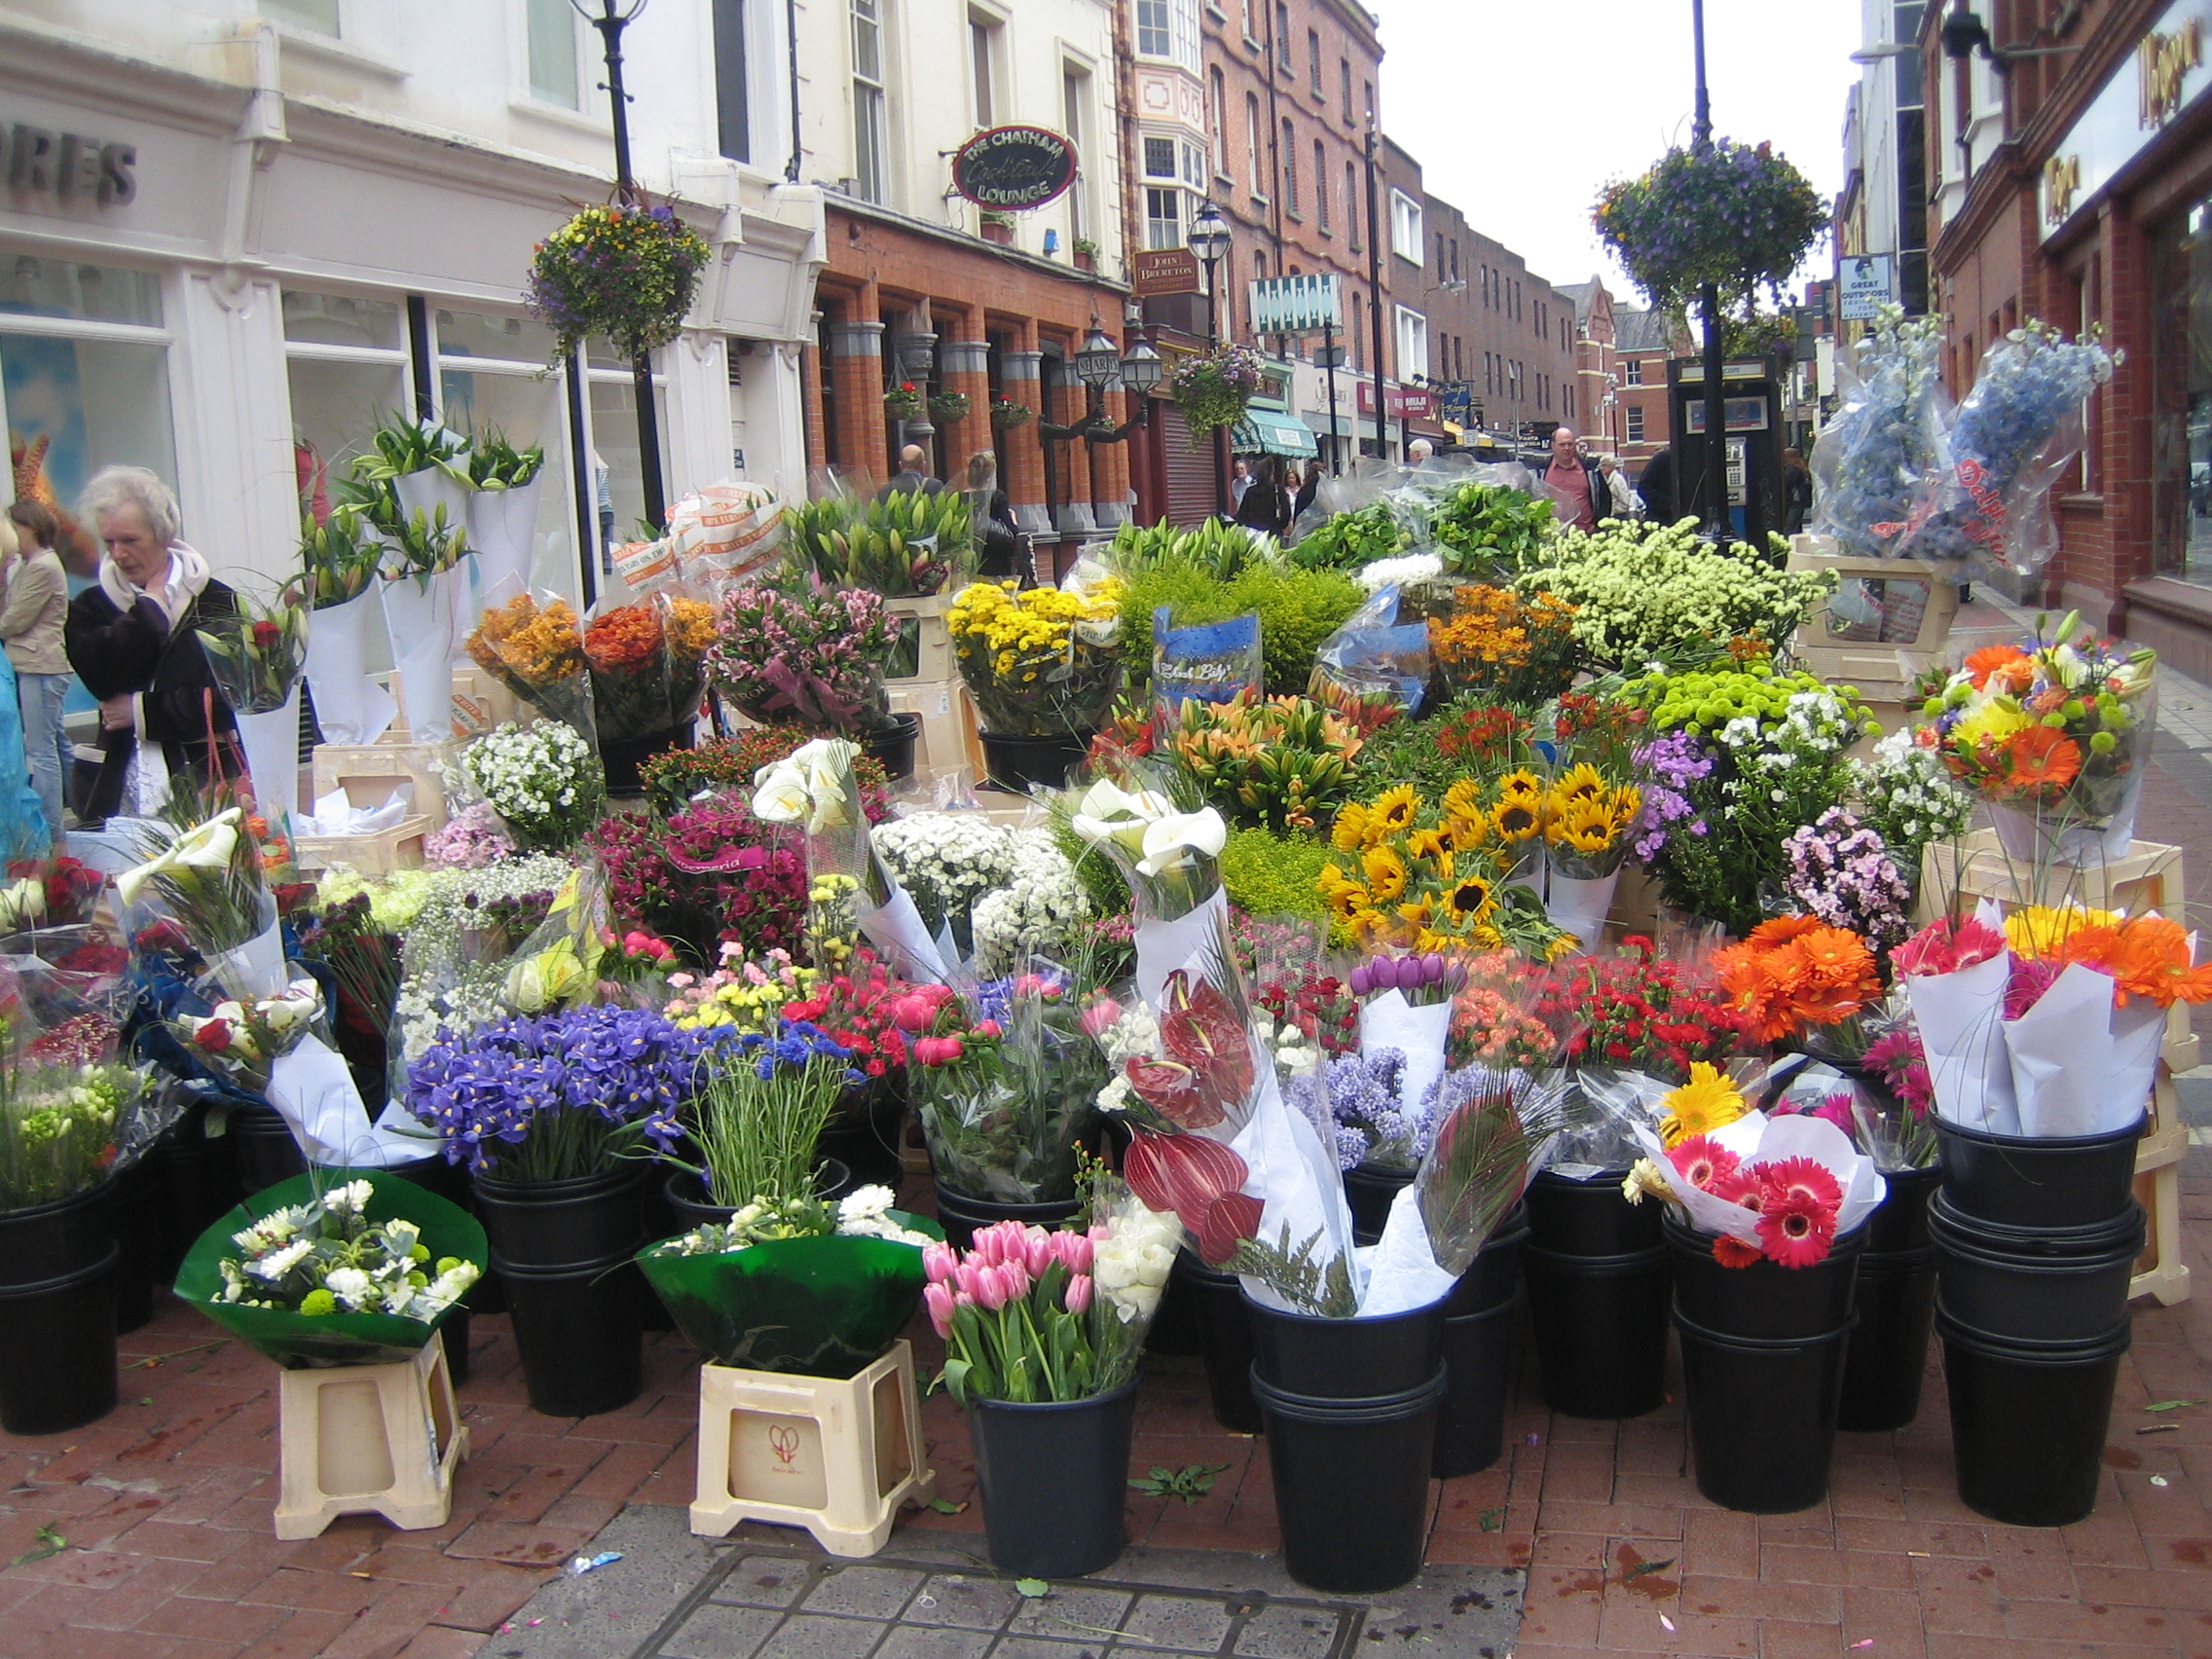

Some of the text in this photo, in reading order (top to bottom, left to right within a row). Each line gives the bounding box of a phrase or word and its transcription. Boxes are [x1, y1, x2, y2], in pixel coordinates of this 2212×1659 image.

[963, 129, 1065, 161] THE CHATHAM
[0, 123, 136, 207] RES
[977, 180, 1051, 204] LOUNGE
[1154, 257, 1178, 268] JOHN
[1851, 280, 1879, 289] GREAT
[1841, 289, 1889, 299] OUTDOORS
